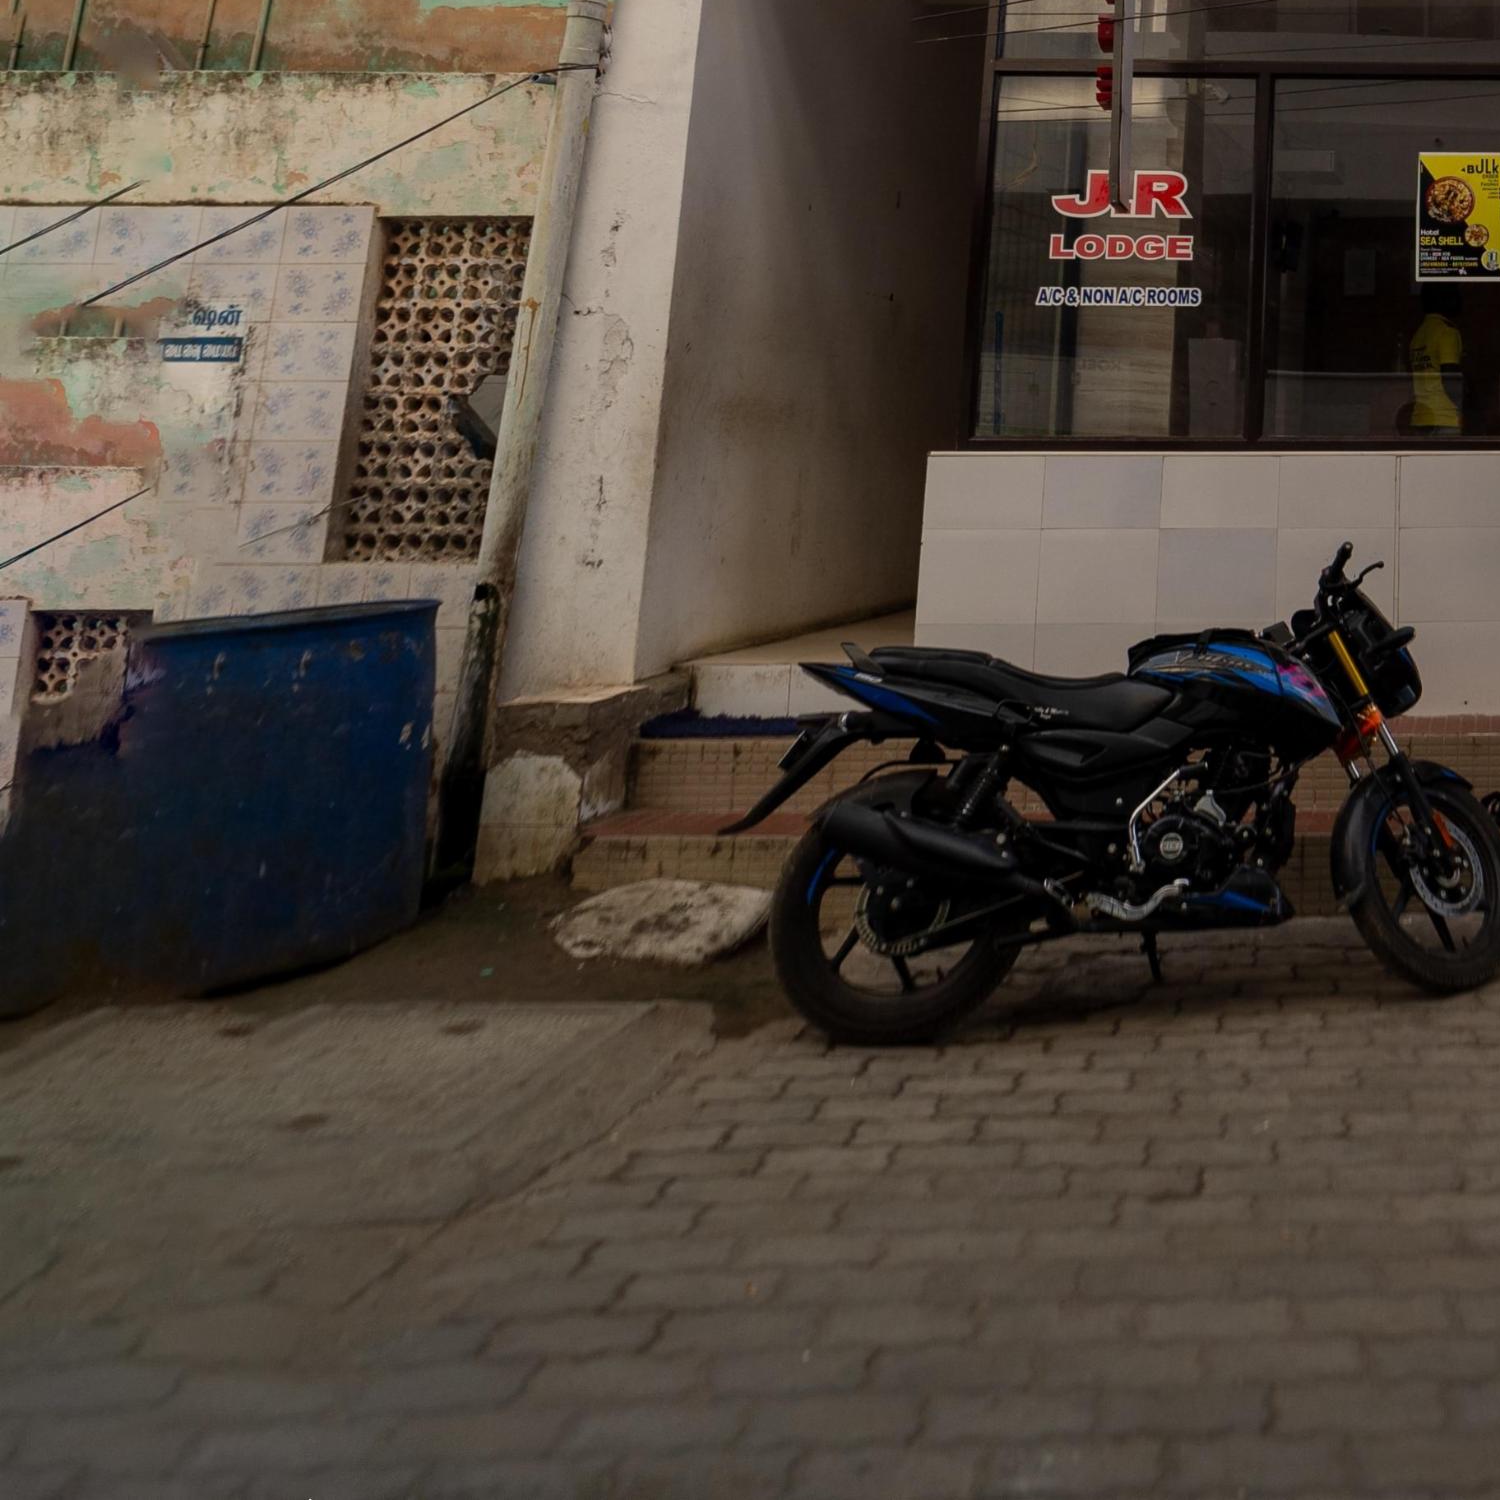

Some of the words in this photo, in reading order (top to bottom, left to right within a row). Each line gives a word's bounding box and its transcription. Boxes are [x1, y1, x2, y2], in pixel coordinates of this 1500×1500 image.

[1049, 234, 1193, 261] LODGE
[1420, 236, 1437, 246] SEA
[1438, 236, 1464, 246] SHELL
[1065, 286, 1079, 307] &
[1080, 286, 1117, 306] NON
[1117, 287, 1145, 306] A/C
[1145, 287, 1201, 306] ROOMS
